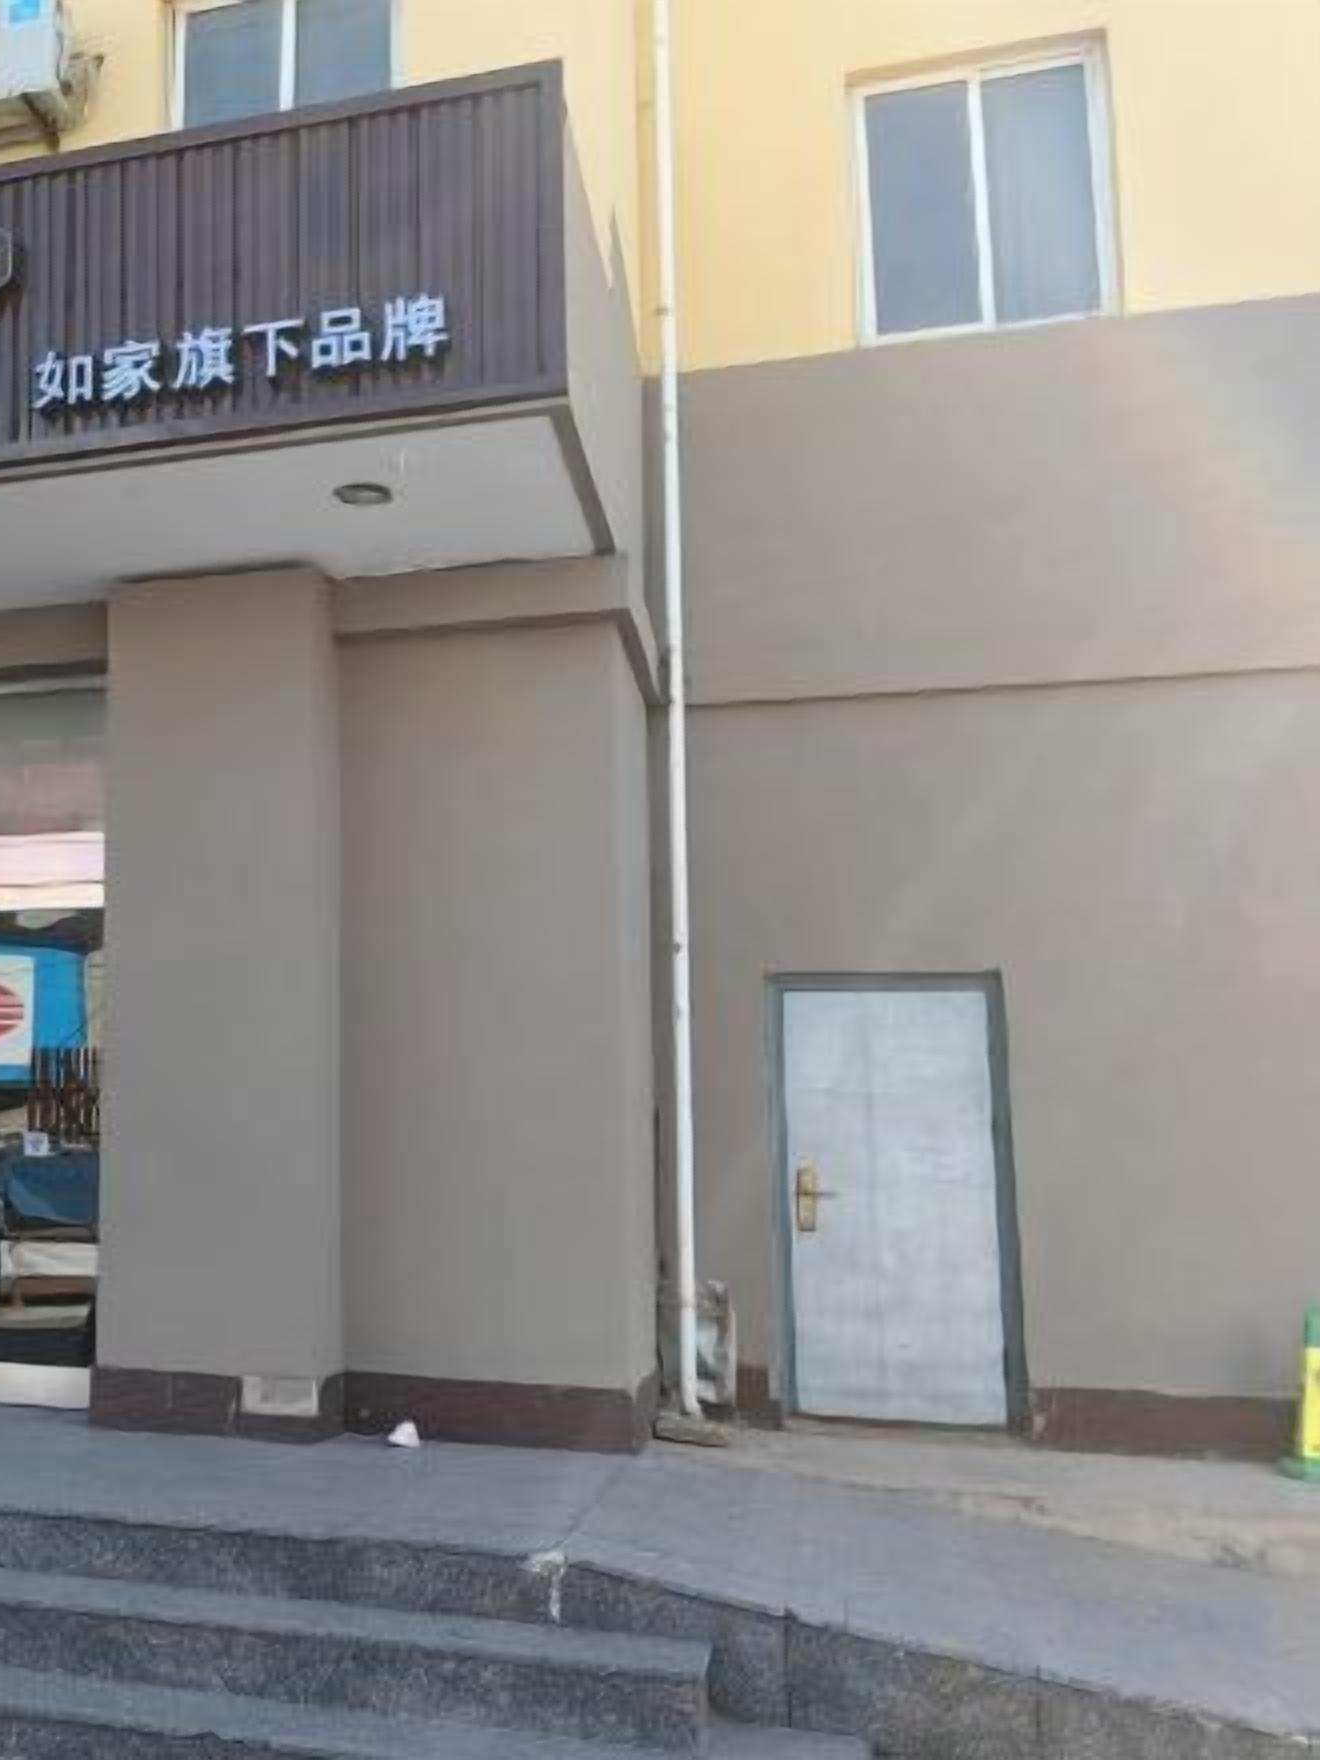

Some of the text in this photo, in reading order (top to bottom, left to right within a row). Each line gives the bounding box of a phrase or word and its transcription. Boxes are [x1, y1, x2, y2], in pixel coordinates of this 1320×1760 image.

[34, 295, 448, 409] 如家旗下品牌
